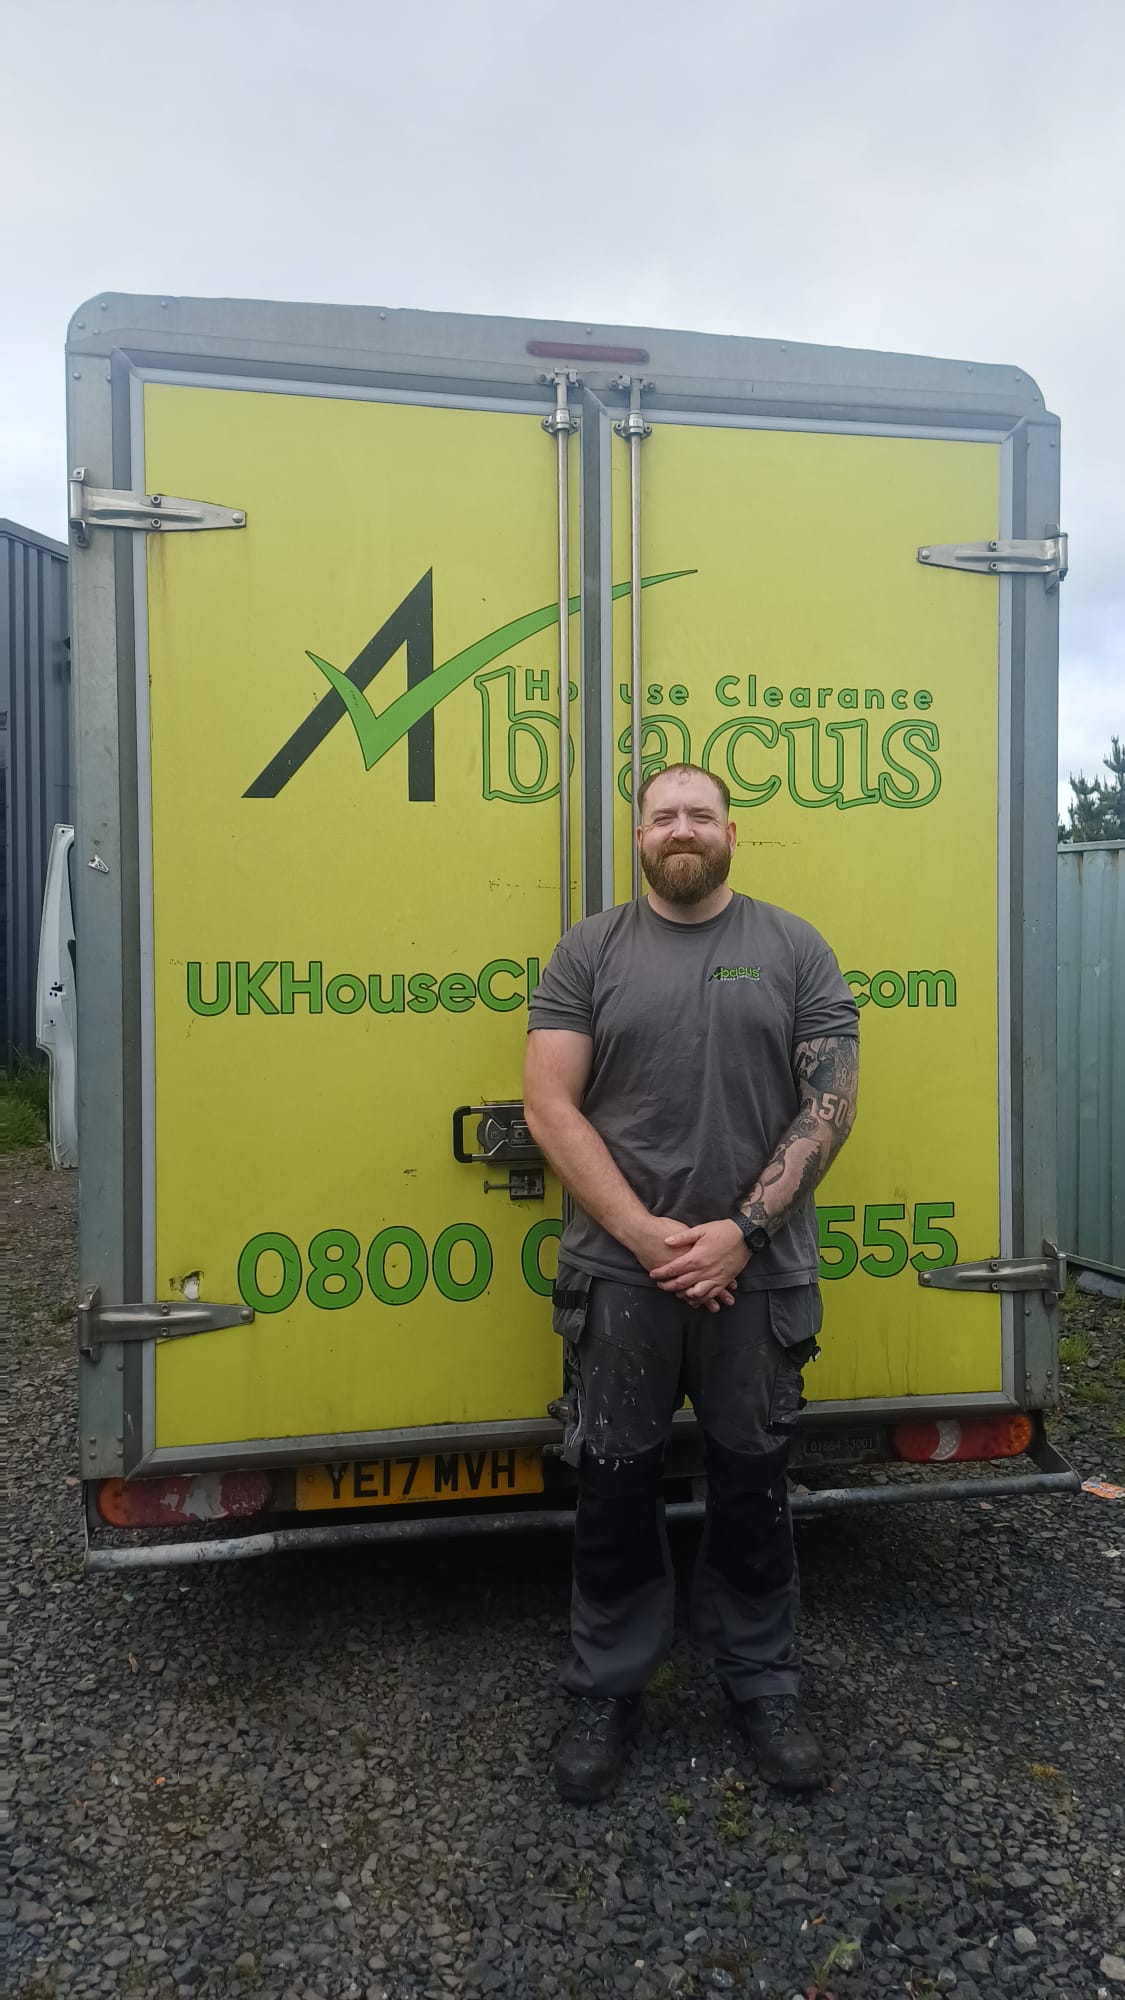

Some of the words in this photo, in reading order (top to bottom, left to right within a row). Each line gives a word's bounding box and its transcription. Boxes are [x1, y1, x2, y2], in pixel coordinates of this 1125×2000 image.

[525, 669, 690, 706] House
[715, 674, 934, 710] Clearance
[818, 1092, 850, 1129] 50
[237, 1222, 493, 1314] 0800
[815, 1202, 959, 1280] 555
[324, 1456, 420, 1500] YE17
[434, 1450, 516, 1493] MVH
